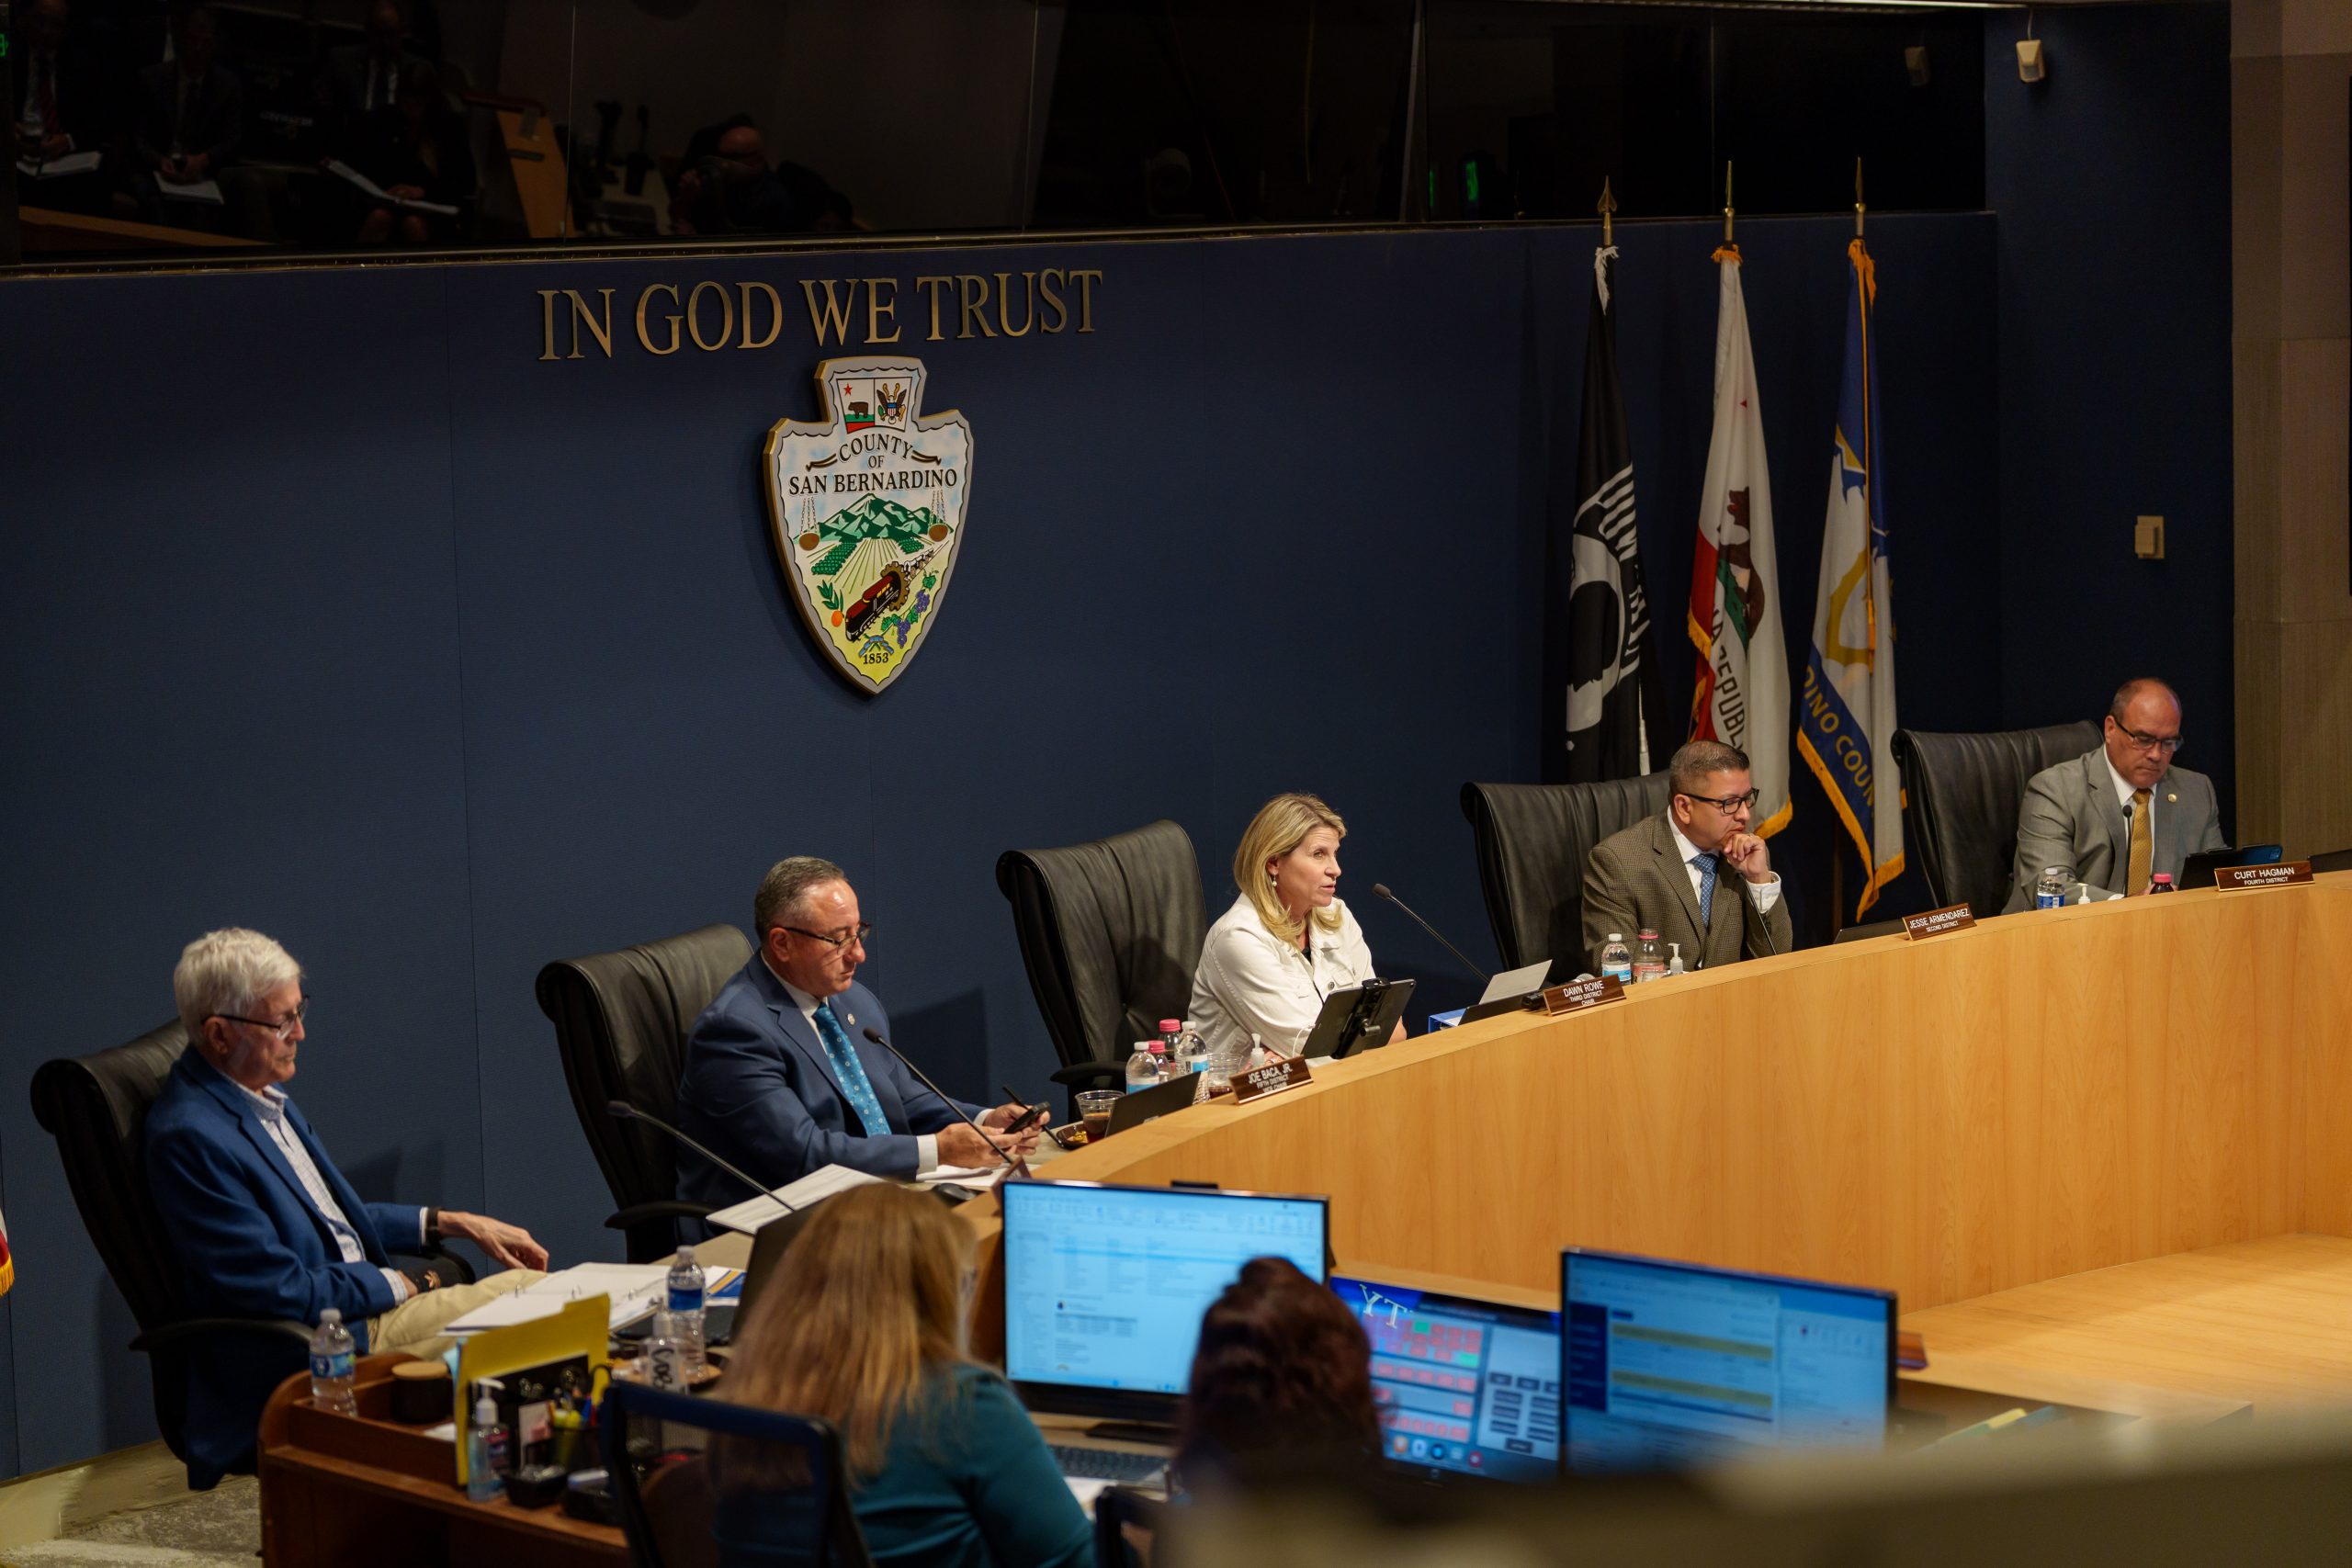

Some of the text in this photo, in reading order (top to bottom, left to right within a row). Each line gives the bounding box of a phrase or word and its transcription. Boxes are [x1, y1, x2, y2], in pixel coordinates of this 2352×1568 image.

[537, 268, 1102, 361] IN GOD WE TRUST
[839, 434, 913, 461] COUNTY
[867, 455, 885, 468] OF
[789, 468, 957, 495] SAN BERNARDINO
[863, 652, 889, 664] 1853
[2233, 867, 2295, 880] CURT HAGMAN
[1909, 908, 1971, 929] JESSE ARMENDAREZ
[1563, 980, 1605, 997] DAWN ROWE
[1583, 990, 1603, 1000] DISTRICT
[1248, 1071, 1262, 1084] JOE
